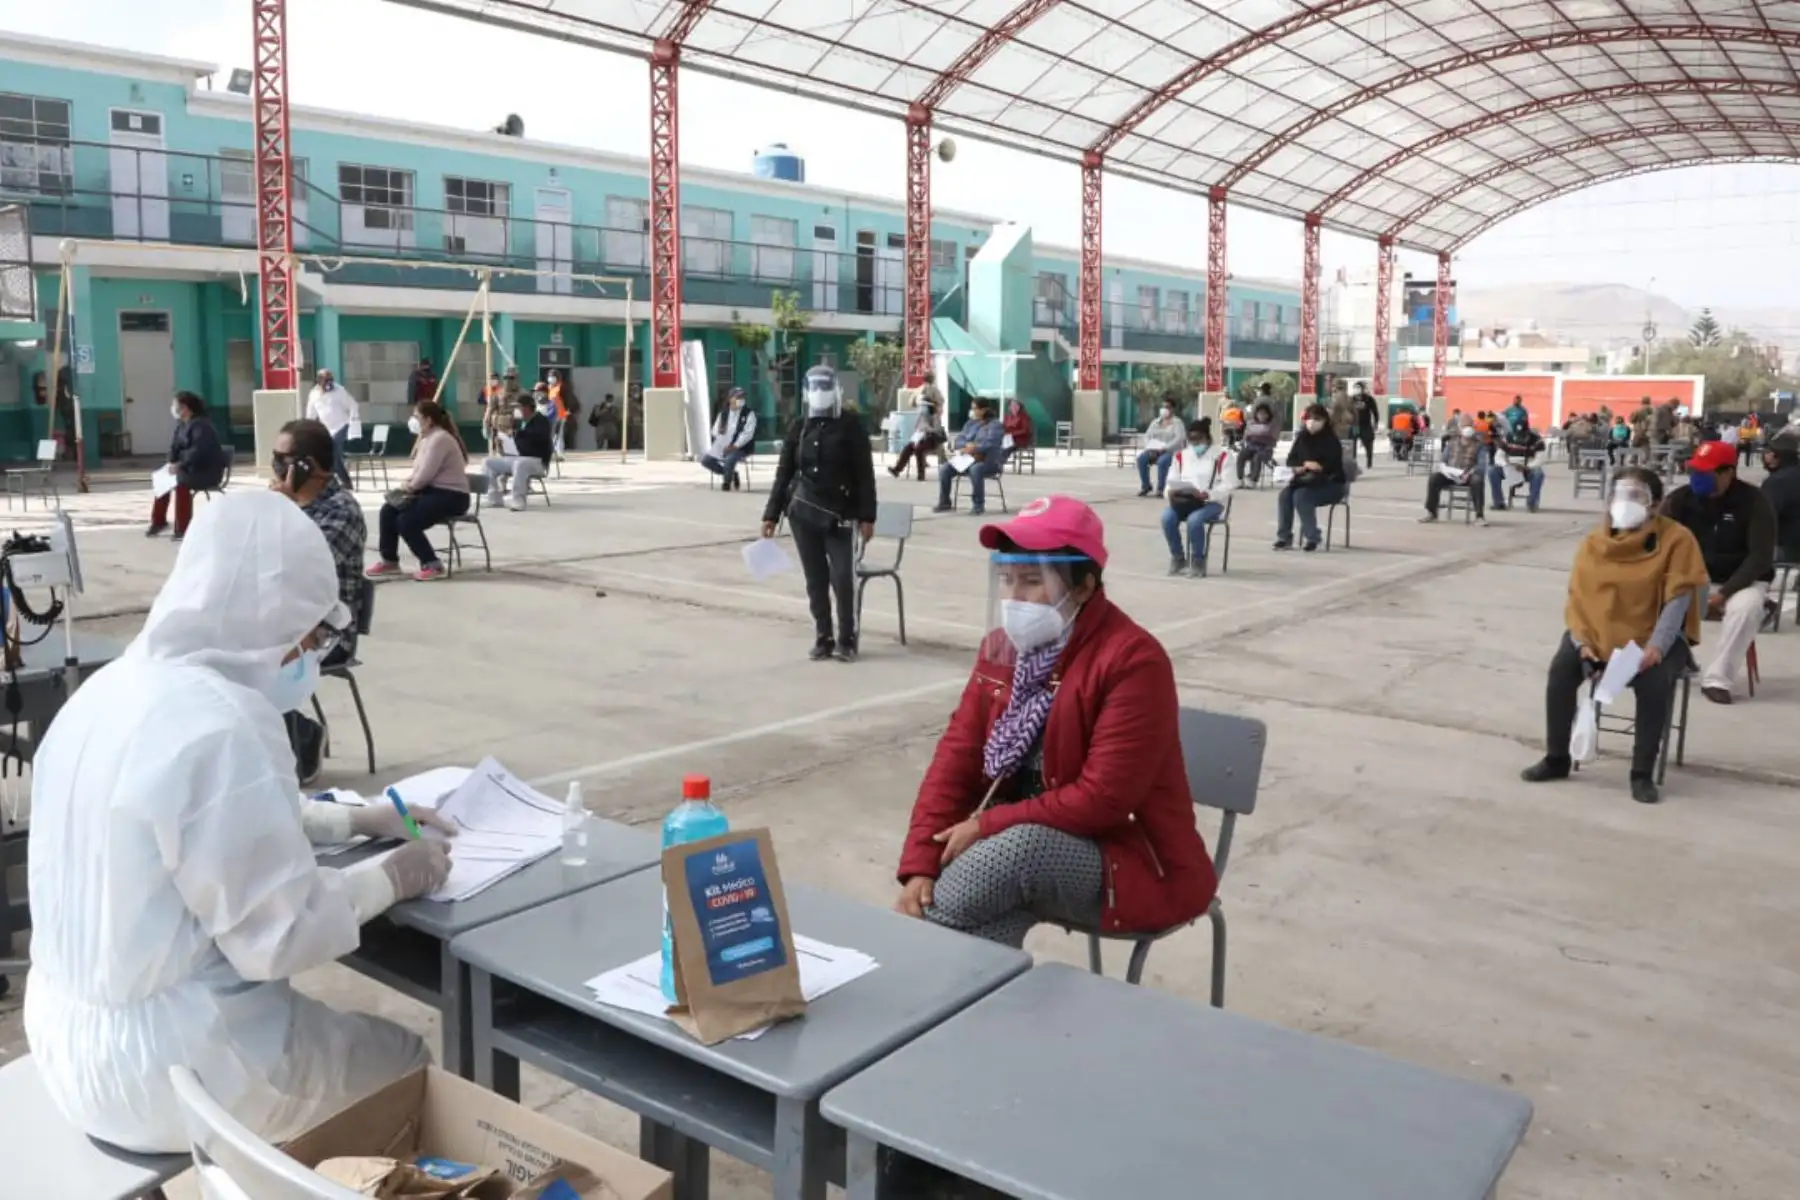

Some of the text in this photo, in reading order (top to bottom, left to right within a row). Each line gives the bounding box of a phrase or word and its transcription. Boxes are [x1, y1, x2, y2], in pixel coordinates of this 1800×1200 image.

[704, 885, 721, 897] Kit
[711, 889, 755, 908] COVID-19
[505, 1159, 535, 1182] AGIL
